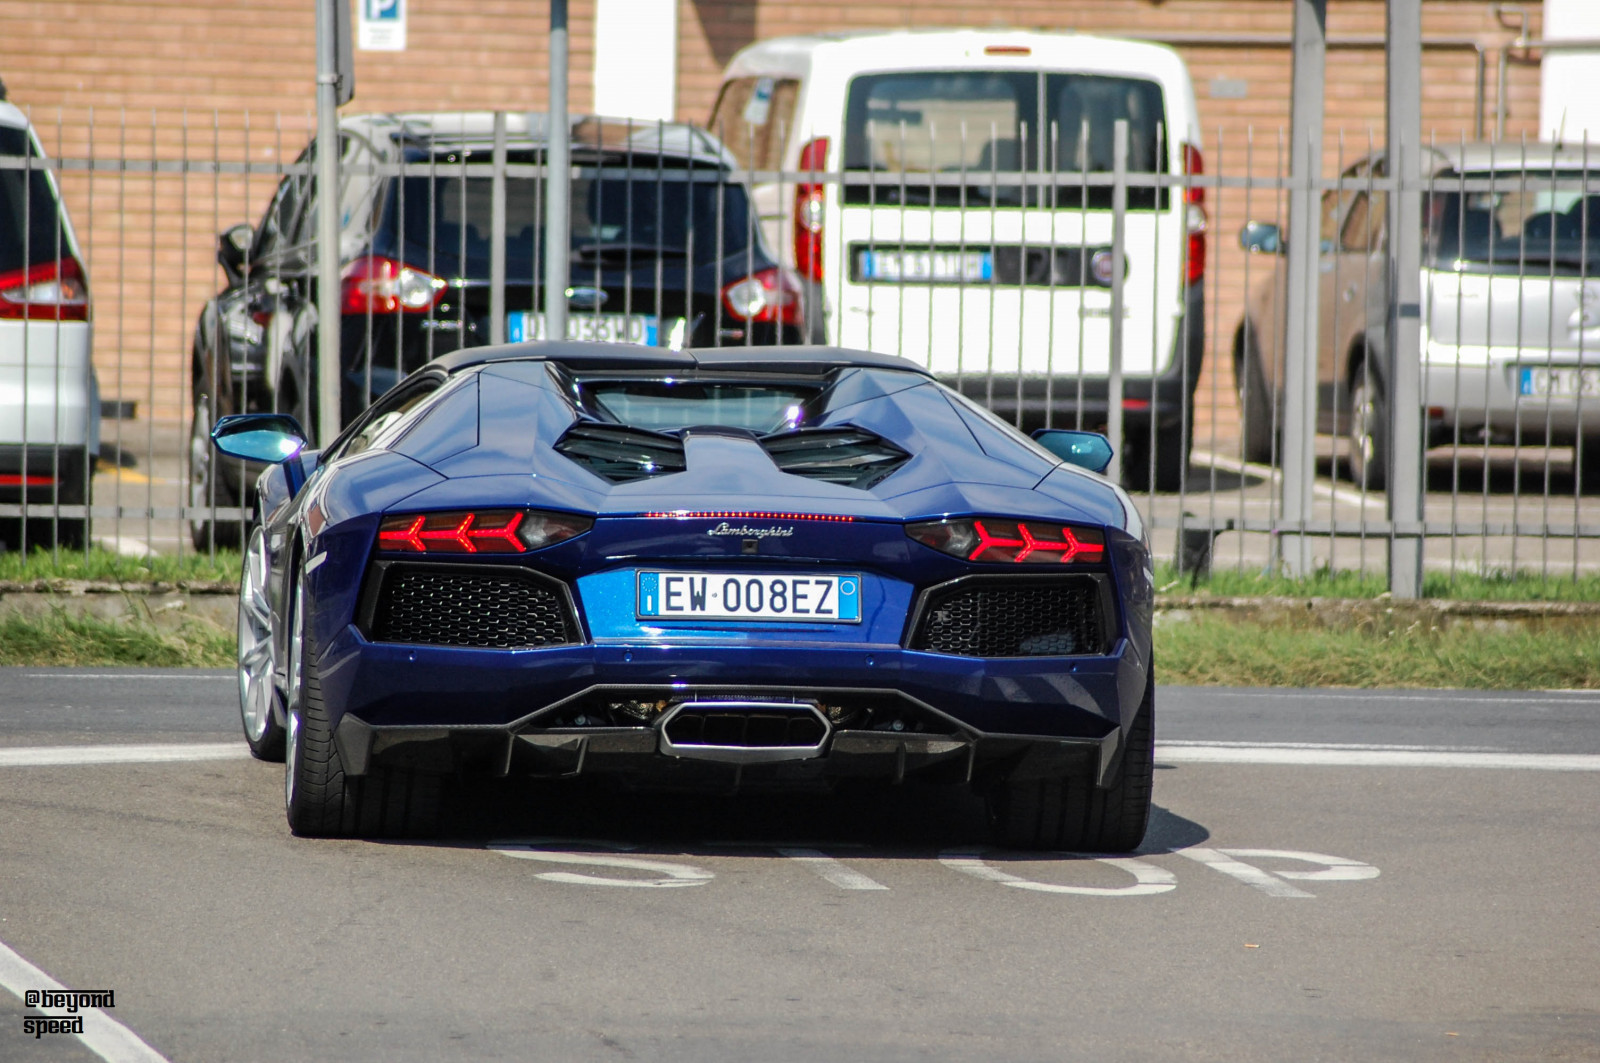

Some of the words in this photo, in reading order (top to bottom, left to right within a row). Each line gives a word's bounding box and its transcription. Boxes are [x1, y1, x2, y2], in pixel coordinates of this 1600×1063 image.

[707, 522, 793, 538] Lamborghini
[665, 577, 707, 611] EW
[723, 578, 833, 614] 008EZ
